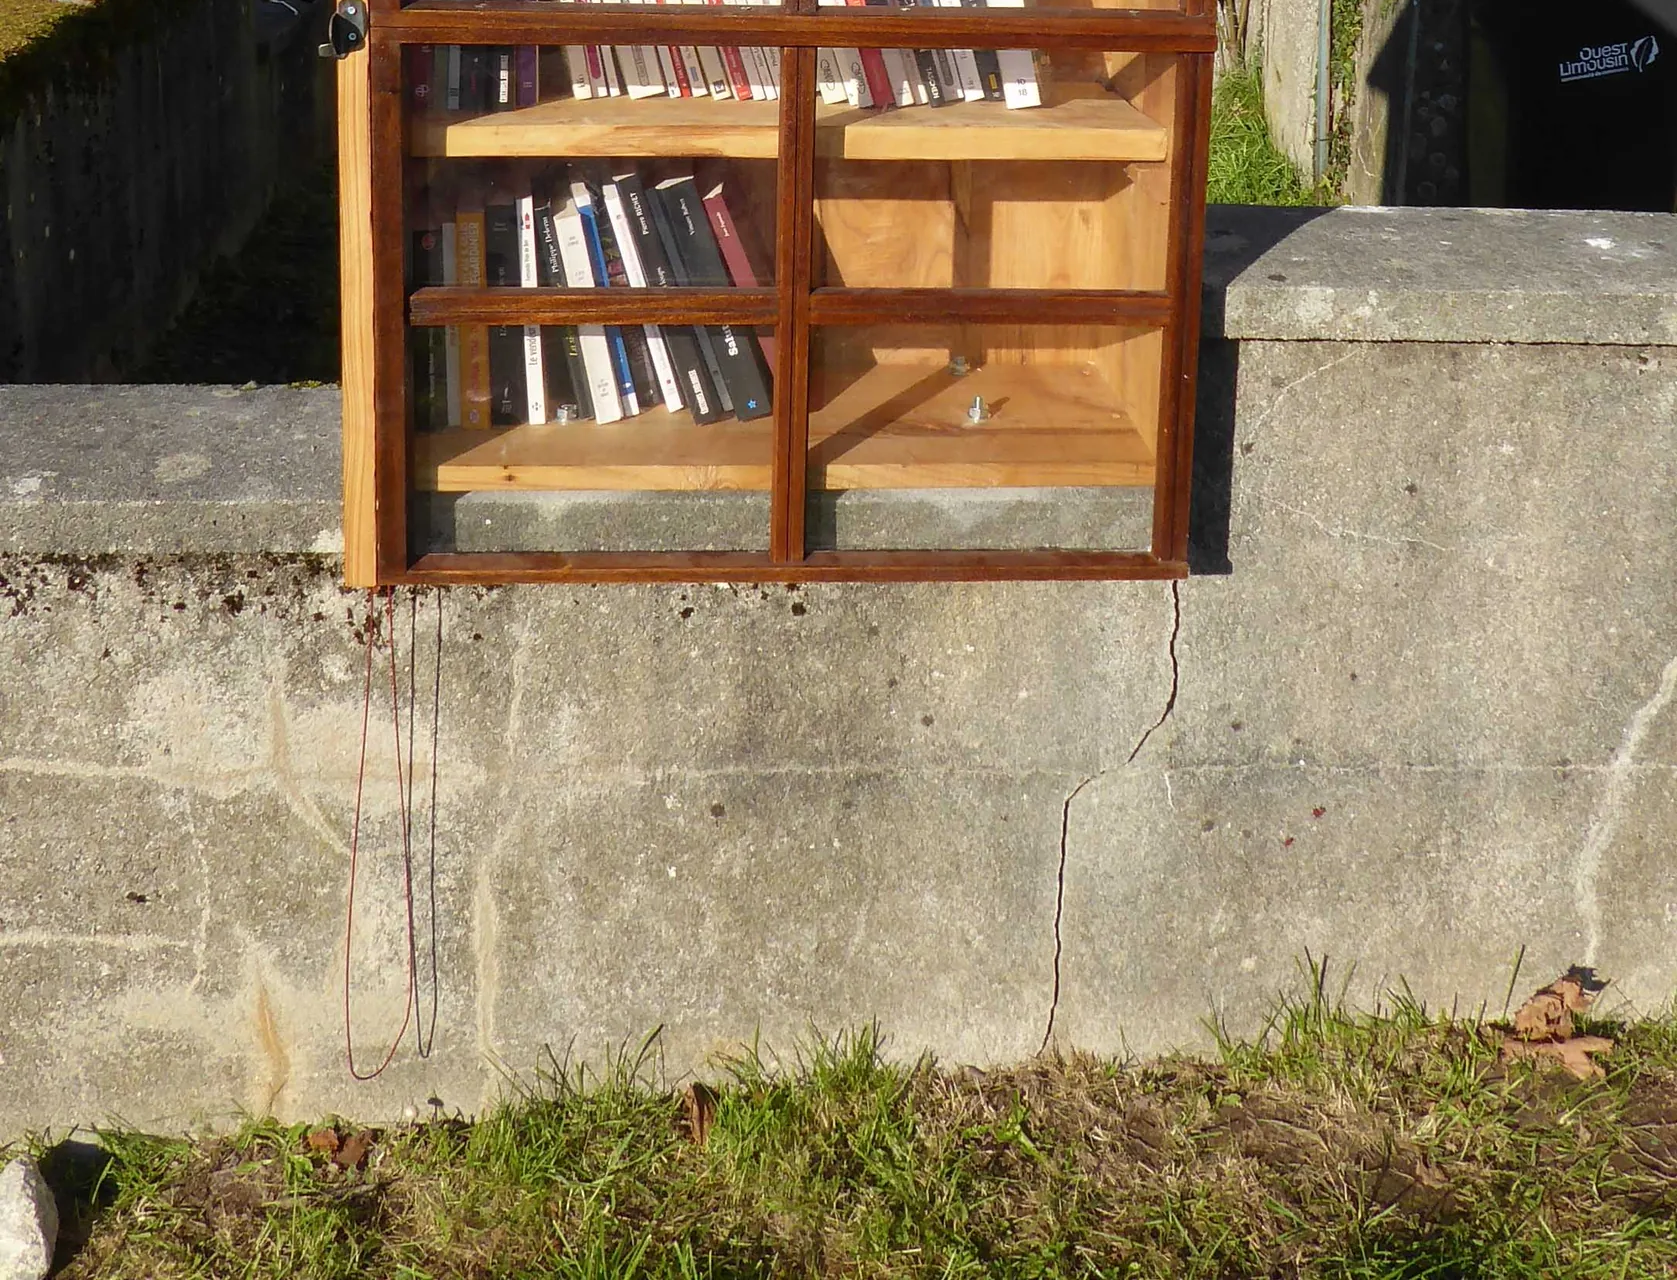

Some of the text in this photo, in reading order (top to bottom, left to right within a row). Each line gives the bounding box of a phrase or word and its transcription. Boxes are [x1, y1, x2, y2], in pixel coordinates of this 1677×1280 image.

[1580, 43, 1628, 60] Ouest
[1560, 54, 1628, 76] Limousin
[629, 191, 643, 216] RICHET
[527, 356, 538, 365] Le
